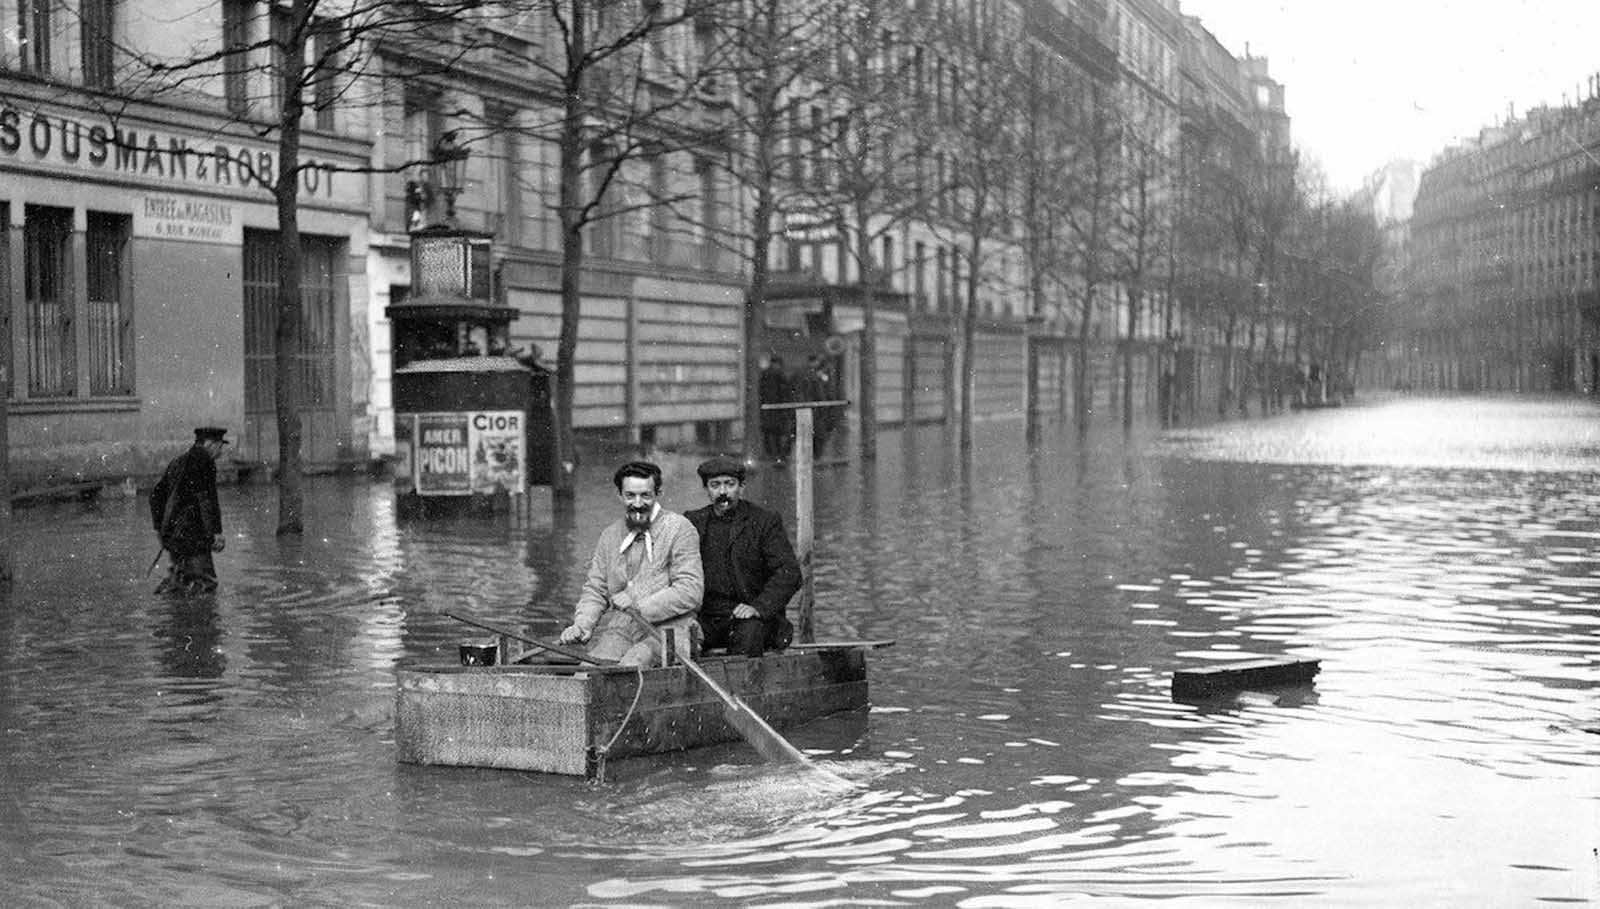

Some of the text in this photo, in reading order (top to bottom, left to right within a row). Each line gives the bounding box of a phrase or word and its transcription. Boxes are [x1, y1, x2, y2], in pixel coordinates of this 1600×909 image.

[214, 145, 337, 198] ROBOT
[166, 223, 184, 236] RUE
[423, 428, 462, 445] AMER
[419, 446, 468, 475] PICON
